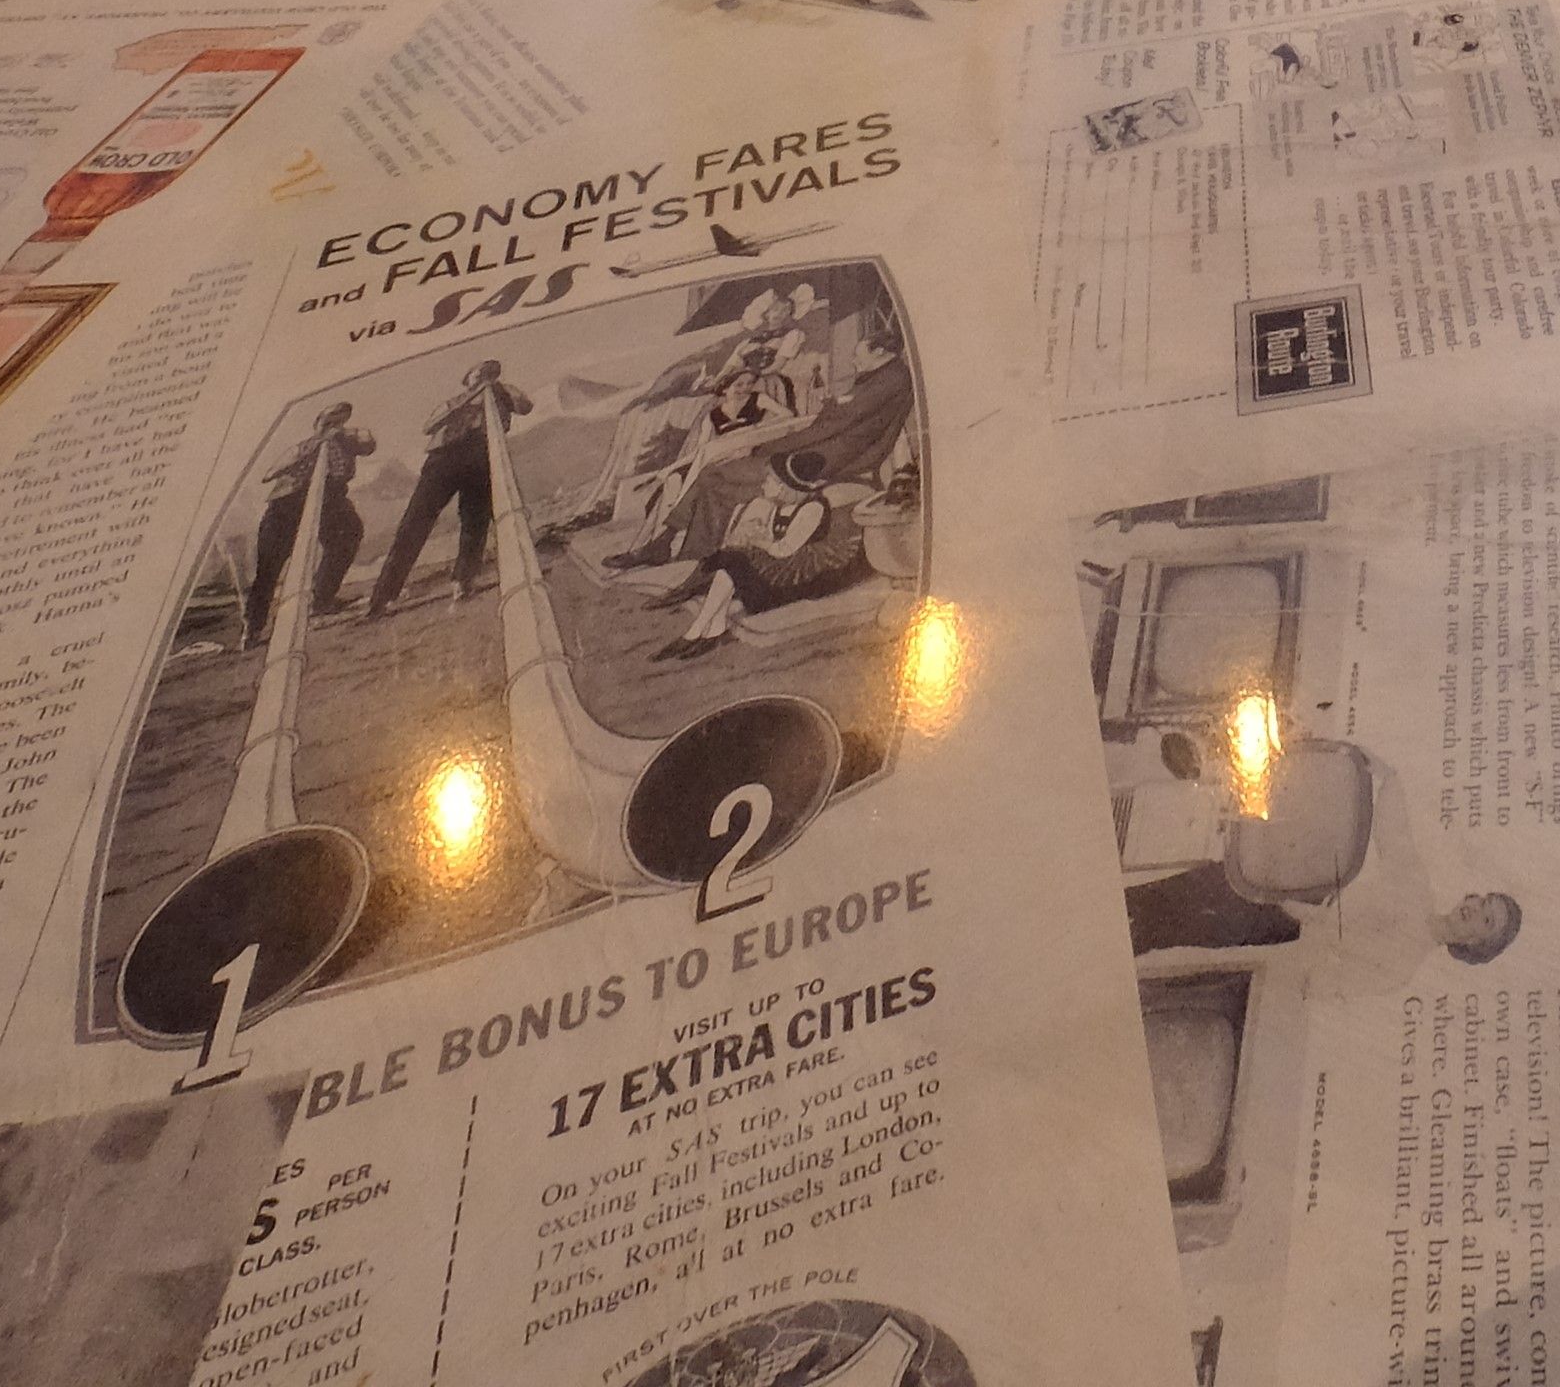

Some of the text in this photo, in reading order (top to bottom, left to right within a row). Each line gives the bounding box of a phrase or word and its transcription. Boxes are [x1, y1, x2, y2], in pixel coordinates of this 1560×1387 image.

[298, 147, 901, 314] and FALL FESTIVALS
[317, 112, 894, 269] ECONOMY FARES
[350, 264, 589, 343] via SAS
[695, 781, 774, 923] 2
[171, 943, 260, 1096] 1
[437, 975, 627, 1075] BONUS
[645, 947, 710, 1002] TO
[731, 869, 933, 973] EUROPE
[674, 978, 825, 1043] VISIT UP TO
[547, 967, 938, 1138] 17 EXTRA CITIES
[628, 1047, 845, 1137] AT NO EXTRA FARE.
[824, 1099, 869, 1131] and
[294, 1180, 390, 1227] PERSON
[327, 1163, 373, 1191] PER
[541, 1068, 895, 1208] On your you can
